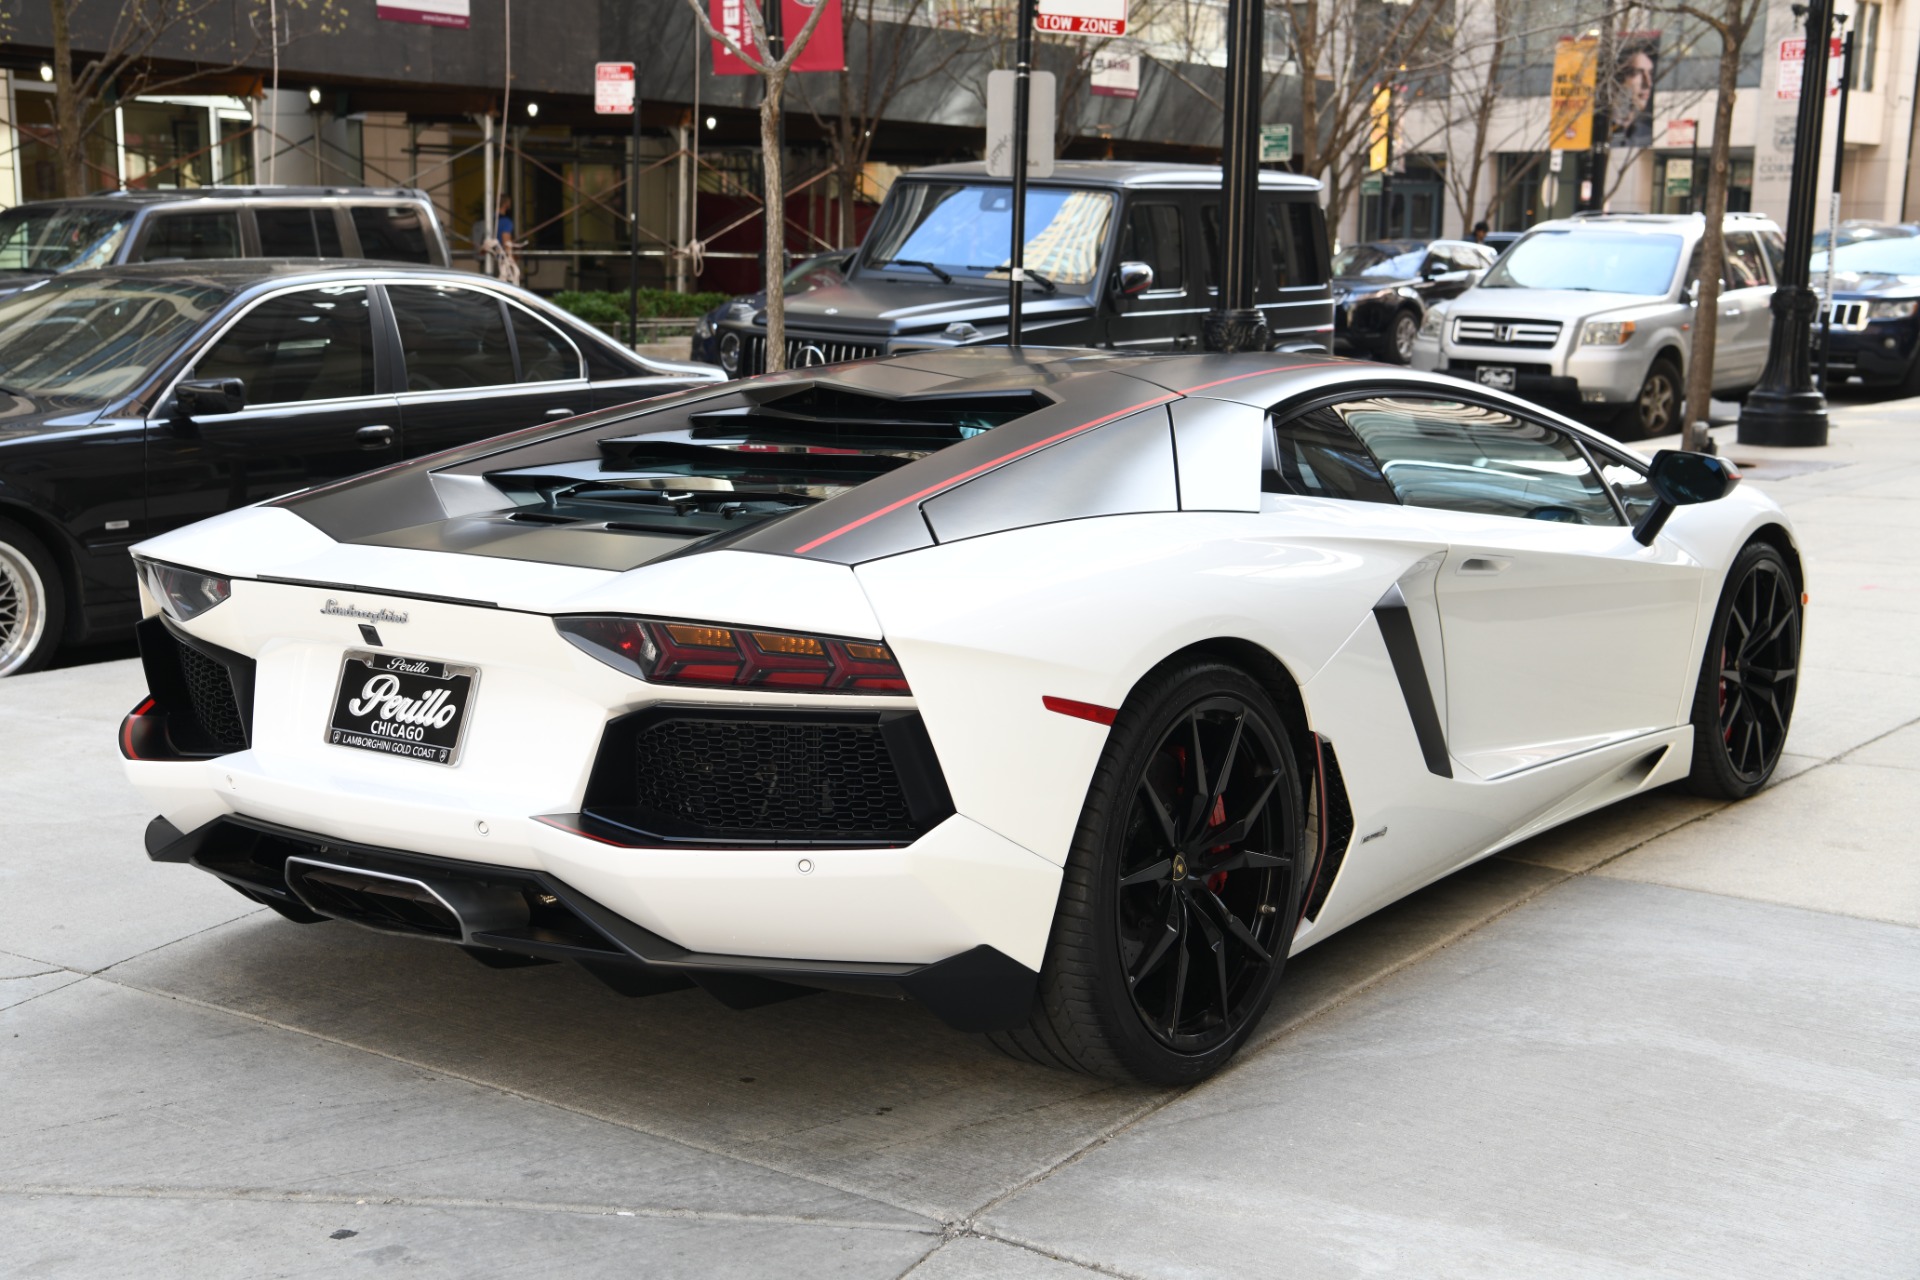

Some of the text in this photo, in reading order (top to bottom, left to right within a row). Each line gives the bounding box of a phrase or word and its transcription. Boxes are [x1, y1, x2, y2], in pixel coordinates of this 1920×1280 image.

[1041, 15, 1118, 34] TOW ZONE
[320, 598, 409, 624] Lamborghini
[386, 657, 430, 674] Perillo
[349, 674, 456, 729] Perillo
[370, 720, 424, 741] CHICAGO
[342, 734, 436, 759] LAMBORGHINI GOLD COAST
